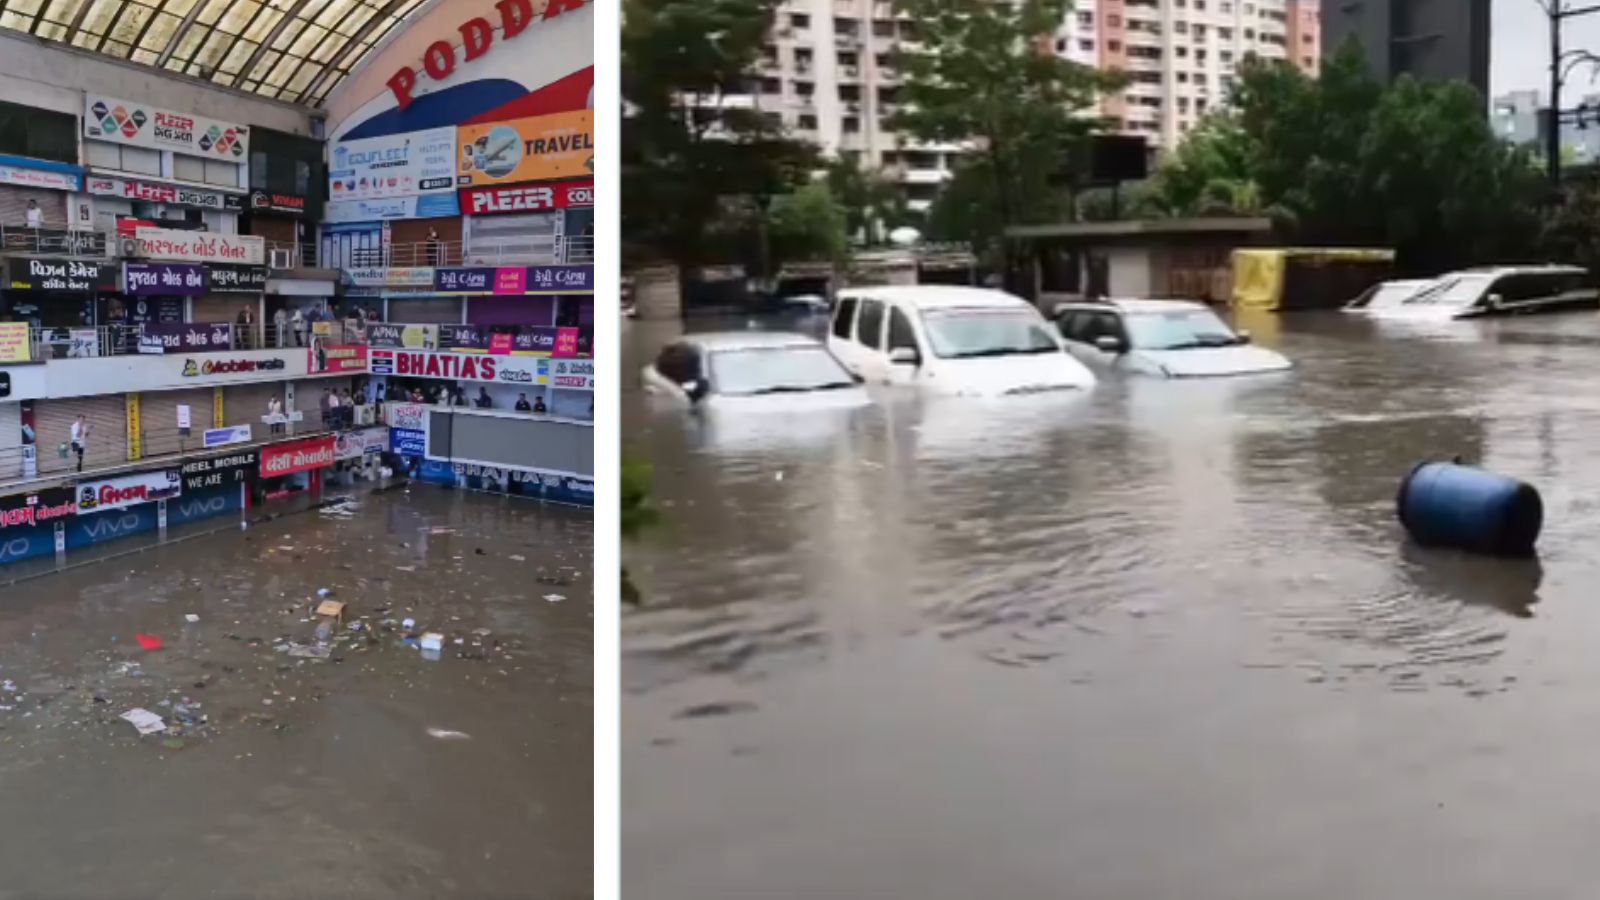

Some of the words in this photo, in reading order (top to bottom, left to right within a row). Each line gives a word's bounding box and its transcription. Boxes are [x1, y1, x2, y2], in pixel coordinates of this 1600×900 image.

[154, 112, 194, 130] PLEZER
[525, 133, 593, 156] TRAVEL
[124, 181, 176, 203] PLEZER
[472, 188, 553, 212] PLEZER
[372, 326, 399, 339] APNA
[397, 352, 496, 381] BHATIA'S
[214, 453, 255, 468] MOBILE
[187, 476, 203, 489] WE
[204, 473, 222, 485] ARE
